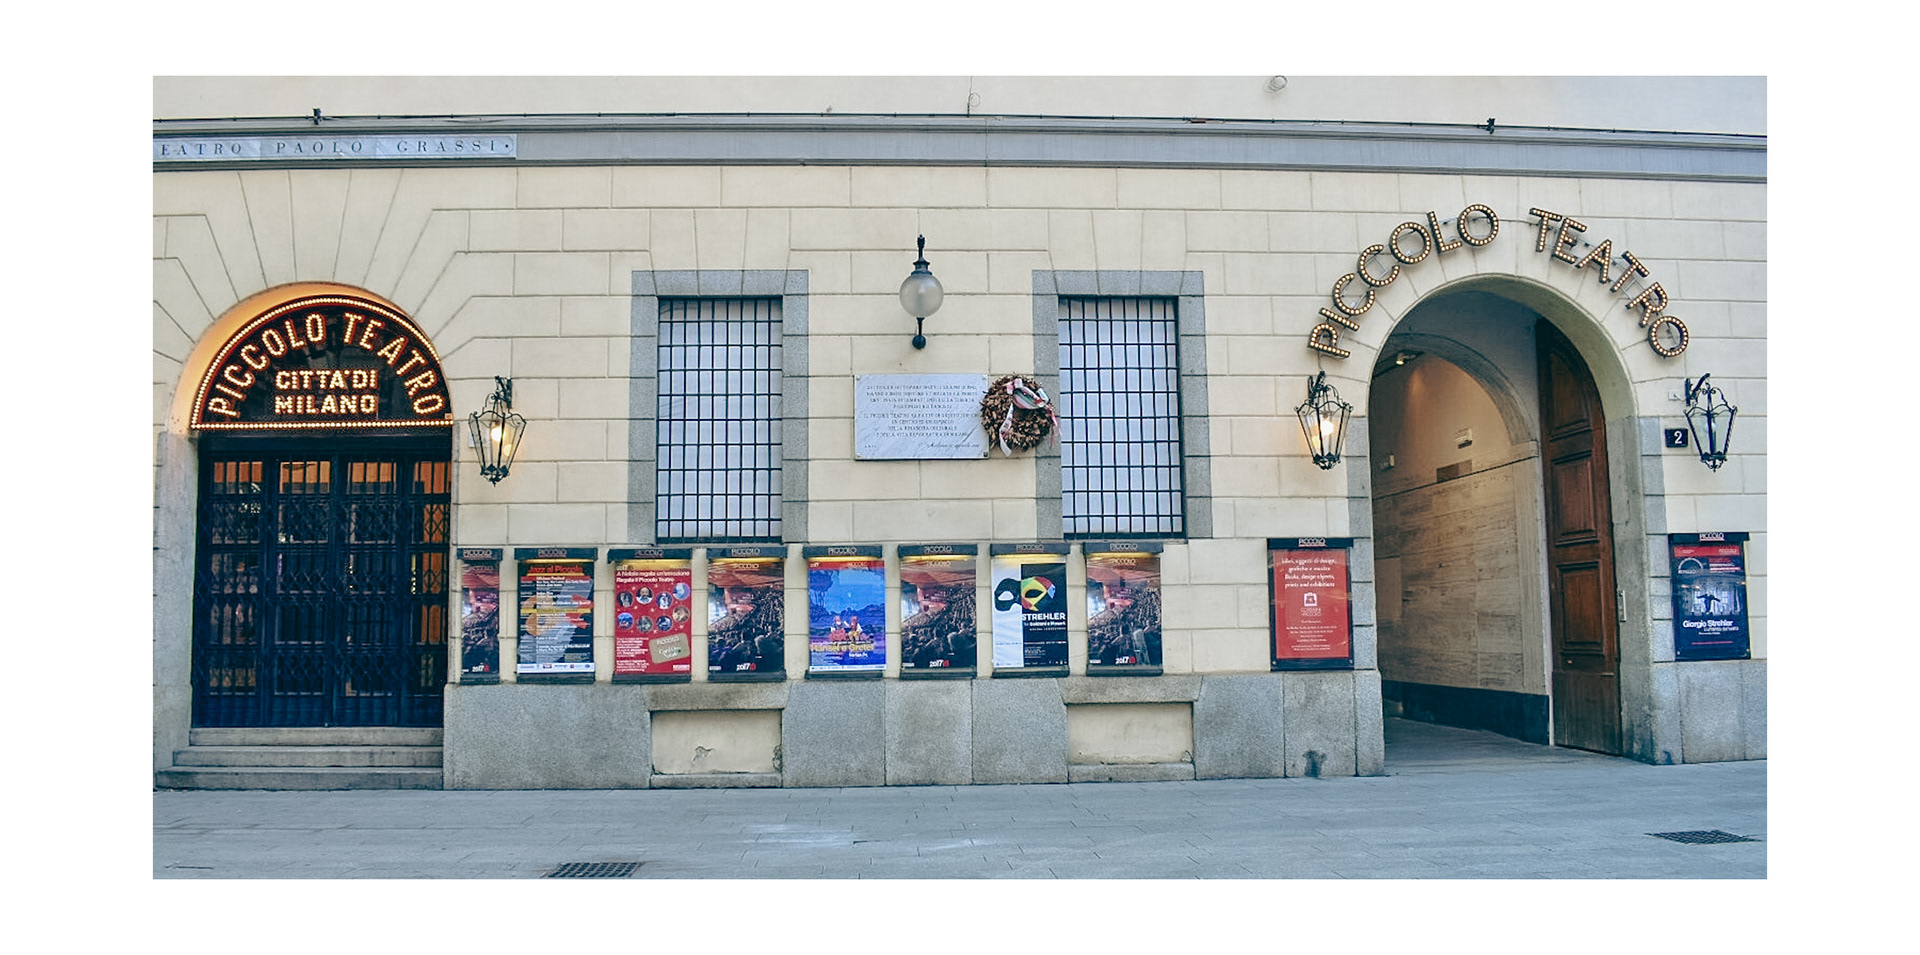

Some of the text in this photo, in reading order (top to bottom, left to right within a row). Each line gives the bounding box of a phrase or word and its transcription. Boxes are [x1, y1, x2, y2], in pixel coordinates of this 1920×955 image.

[276, 141, 362, 153] PAOLO
[396, 140, 495, 152] GRASSI
[1307, 203, 1689, 359] PICCOLO TEATRO
[208, 312, 446, 417] PICCOLO TEATRO
[274, 394, 378, 414] MILANO
[1673, 430, 1683, 445] 2
[828, 546, 857, 554] PICCOLO
[546, 565, 554, 573] al
[555, 565, 583, 573] Piccolo
[1021, 612, 1066, 621] STREHLER
[1682, 619, 1734, 629] Giorgio Strehler
[811, 643, 840, 652] Hansel
[848, 643, 874, 652] Gretel
